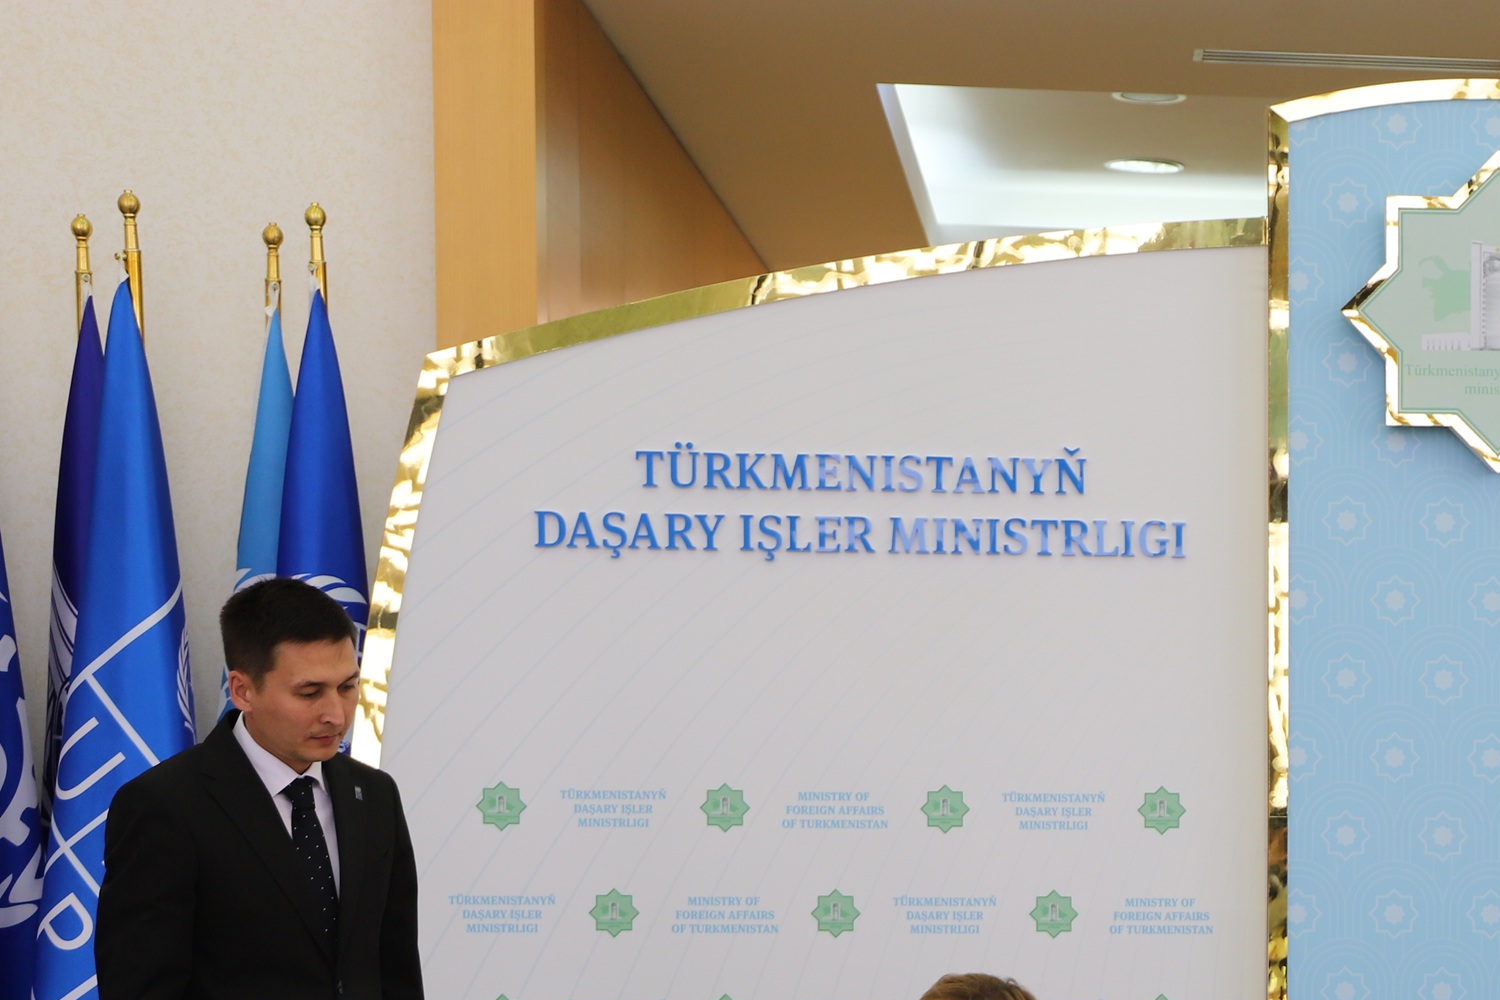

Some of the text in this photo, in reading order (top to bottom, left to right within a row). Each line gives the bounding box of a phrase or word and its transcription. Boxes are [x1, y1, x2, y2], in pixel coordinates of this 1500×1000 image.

[636, 442, 1087, 495] TÜRKMENISTANYŇ
[534, 510, 1187, 561] DAŞARY IŞLER MINISTRLIGI
[798, 791, 870, 801] MINISTRY OF
[573, 804, 653, 815] DAŞARY IŞLER
[786, 805, 885, 815] FOREIGN AFFAIRS
[1015, 807, 1093, 818] DAŞARY IŞLER
[577, 818, 650, 828] MINISTRLIGI
[781, 819, 889, 829] OF TURKMENISTAN
[1019, 820, 1088, 830] MINISTRLIGI
[687, 896, 760, 906] MINISTRY OF
[1125, 898, 1196, 908] MINISTRY OF
[462, 909, 542, 921] DAŞARY IŞLER
[675, 910, 776, 920] FOREIGN AFFAIRS
[906, 911, 984, 922] DAŞARY IŞLER
[1113, 911, 1210, 921] FOREIGN AFFAIRS
[466, 923, 539, 933] MINISTRLIGI
[672, 923, 779, 934] OF TURKMENISTAN
[910, 925, 980, 934] MINISTRLIGI
[1109, 924, 1214, 935] OF TURKMENISTAN
